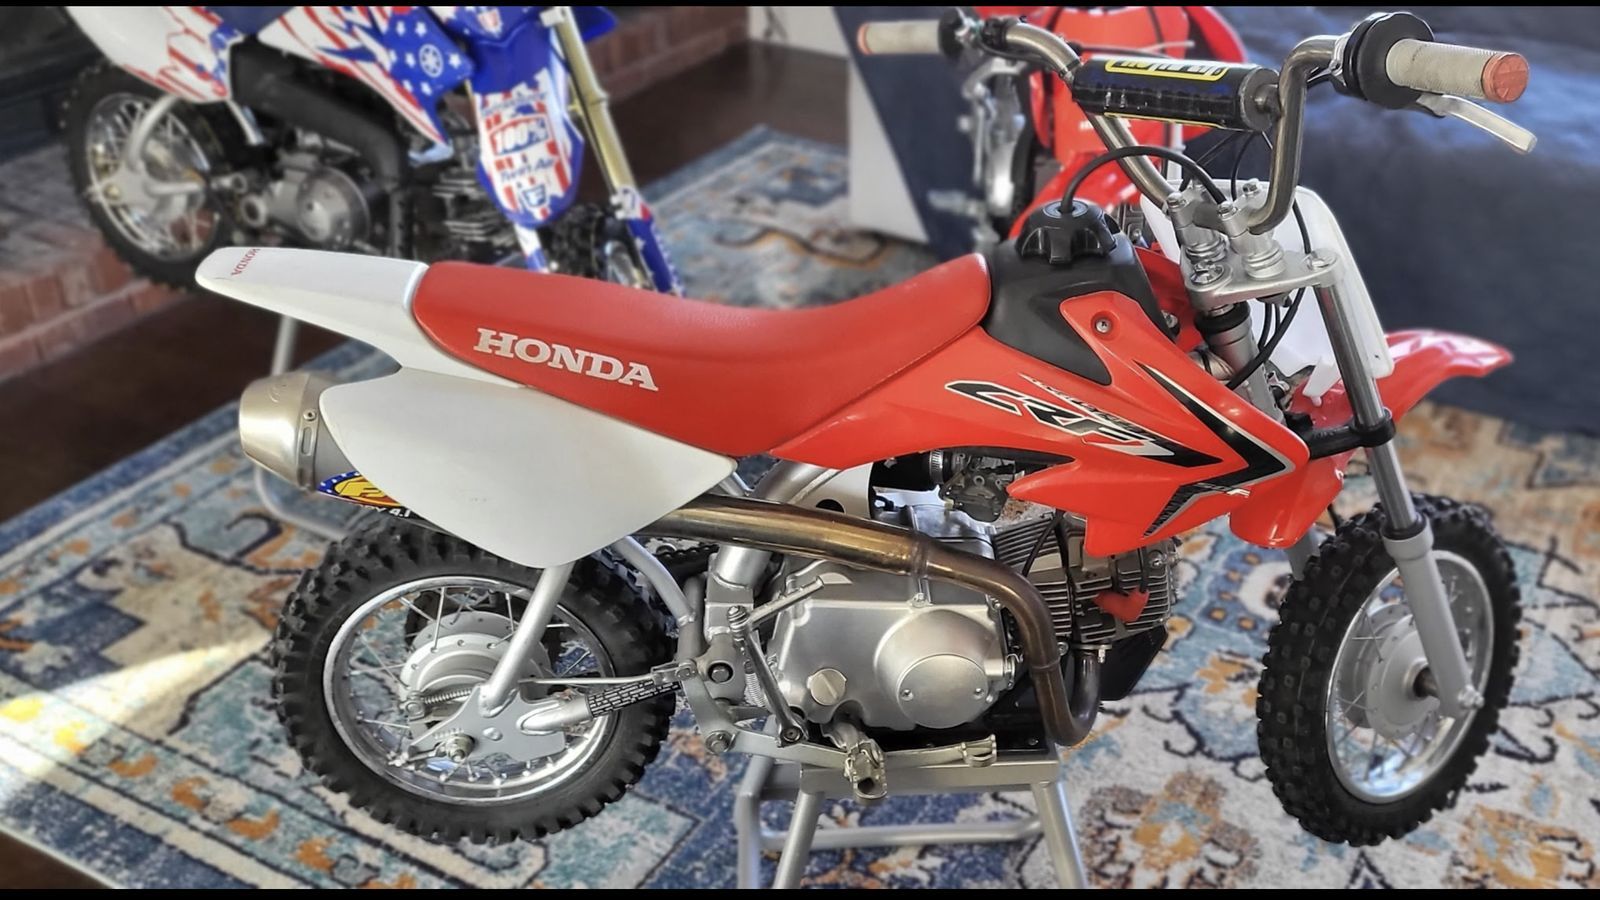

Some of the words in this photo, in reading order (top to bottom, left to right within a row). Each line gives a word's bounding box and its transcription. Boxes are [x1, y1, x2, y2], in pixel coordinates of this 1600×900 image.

[494, 118, 549, 154] 100%
[231, 248, 259, 276] HONDA
[473, 327, 659, 391] HONDA
